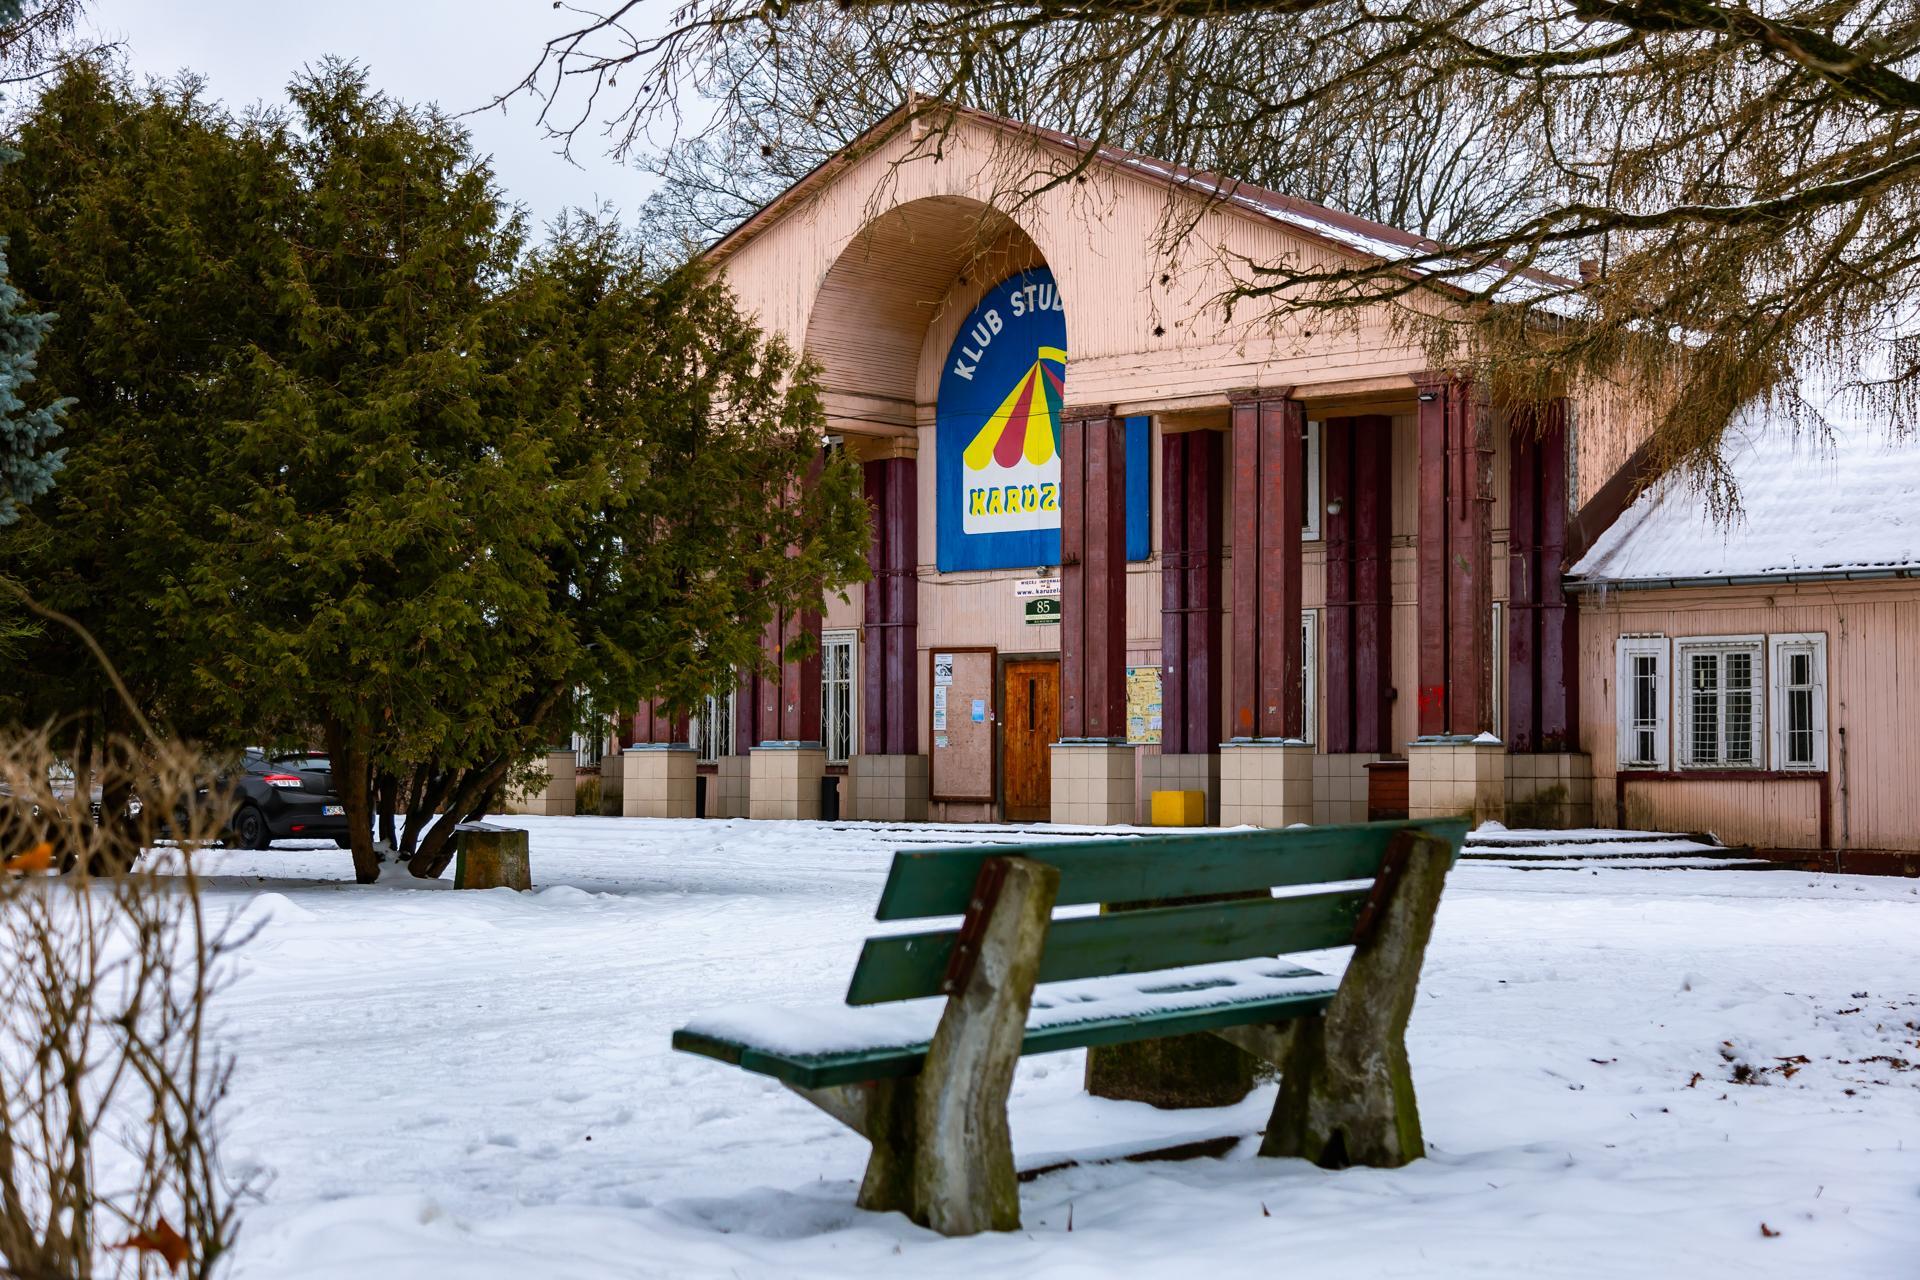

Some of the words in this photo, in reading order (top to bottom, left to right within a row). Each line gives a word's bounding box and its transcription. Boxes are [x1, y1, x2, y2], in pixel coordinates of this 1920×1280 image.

[954, 309, 1003, 380] KLUB
[969, 482, 1061, 517] KARUZ
[1037, 601, 1050, 613] 85
